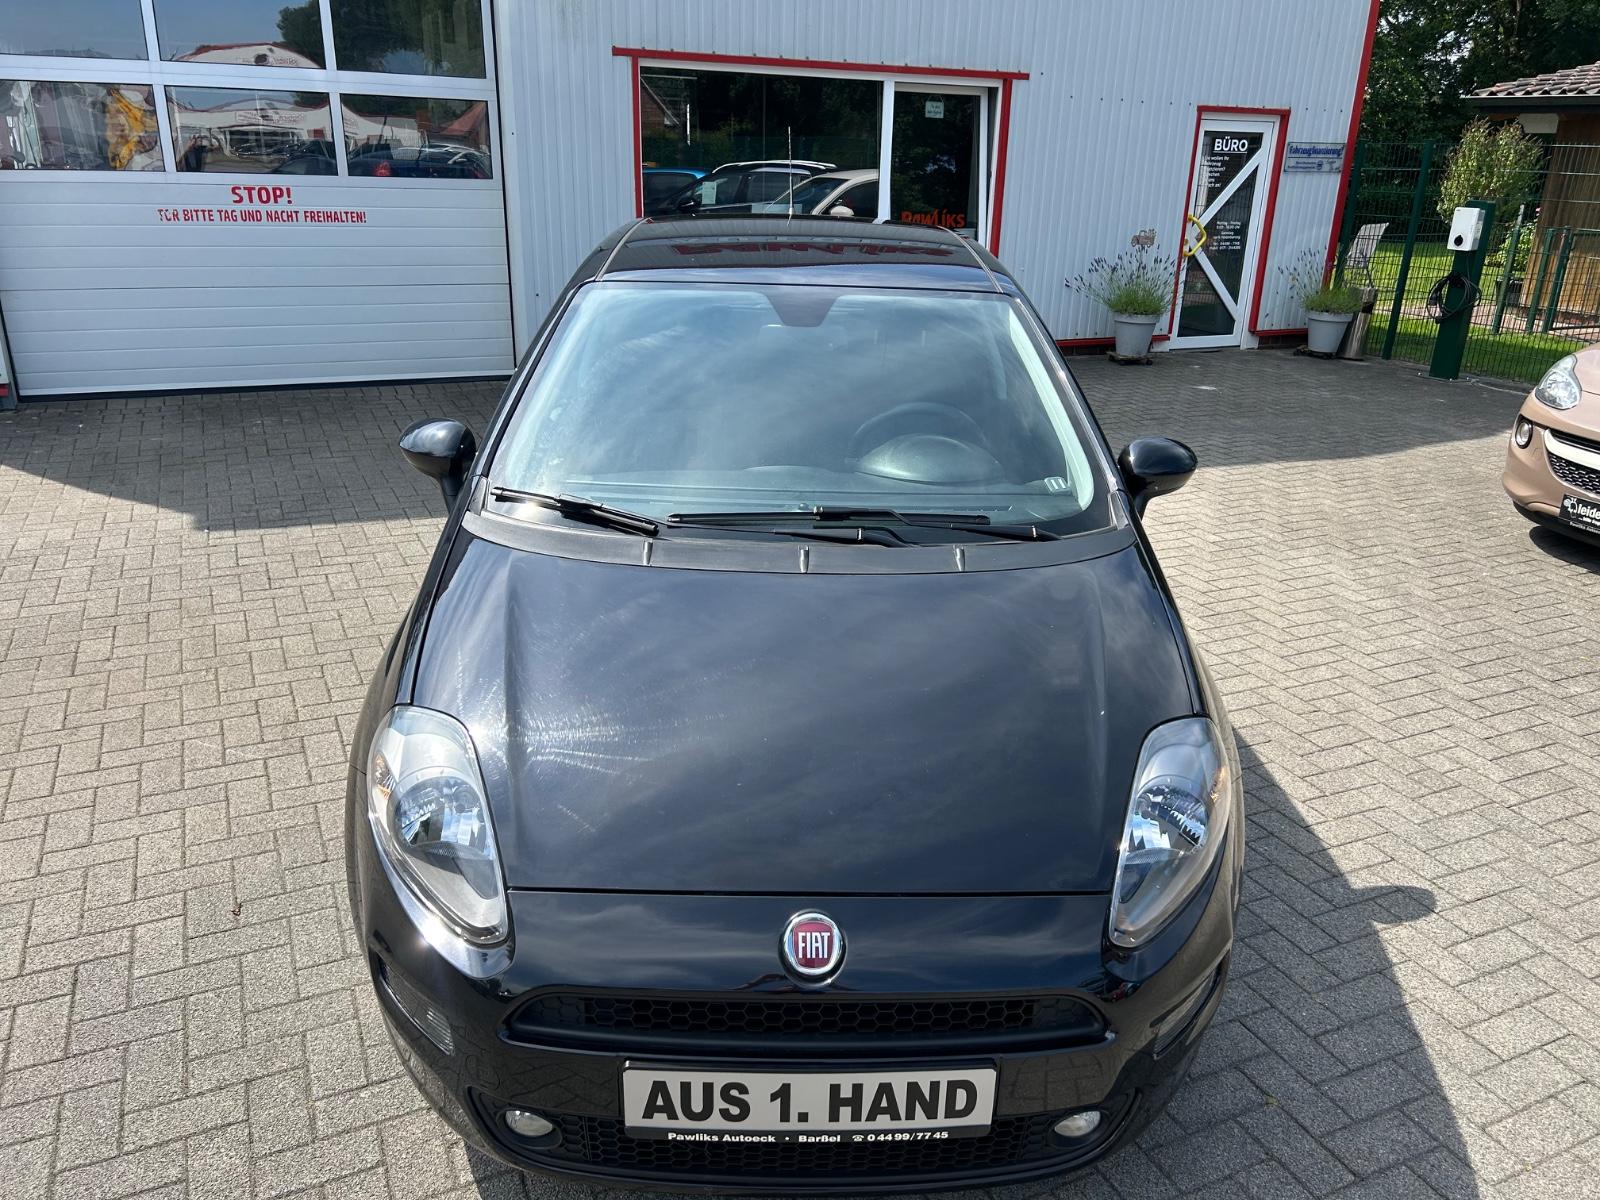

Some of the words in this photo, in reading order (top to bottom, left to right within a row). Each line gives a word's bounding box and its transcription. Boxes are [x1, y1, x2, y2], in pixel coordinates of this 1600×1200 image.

[1214, 135, 1248, 152] BÜRO
[231, 186, 293, 205] STOP!
[183, 209, 214, 222] BITTE
[217, 209, 238, 222] TAG
[240, 210, 263, 223] UND
[266, 210, 300, 223] NACHT
[304, 210, 367, 224] FREIHALTEN!
[798, 931, 831, 959] FIAT
[641, 1080, 751, 1123] AUS
[769, 1082, 809, 1123] 1.
[828, 1079, 978, 1123] HAND
[667, 1132, 719, 1142] Pawliks
[722, 1134, 776, 1143] Autoeck
